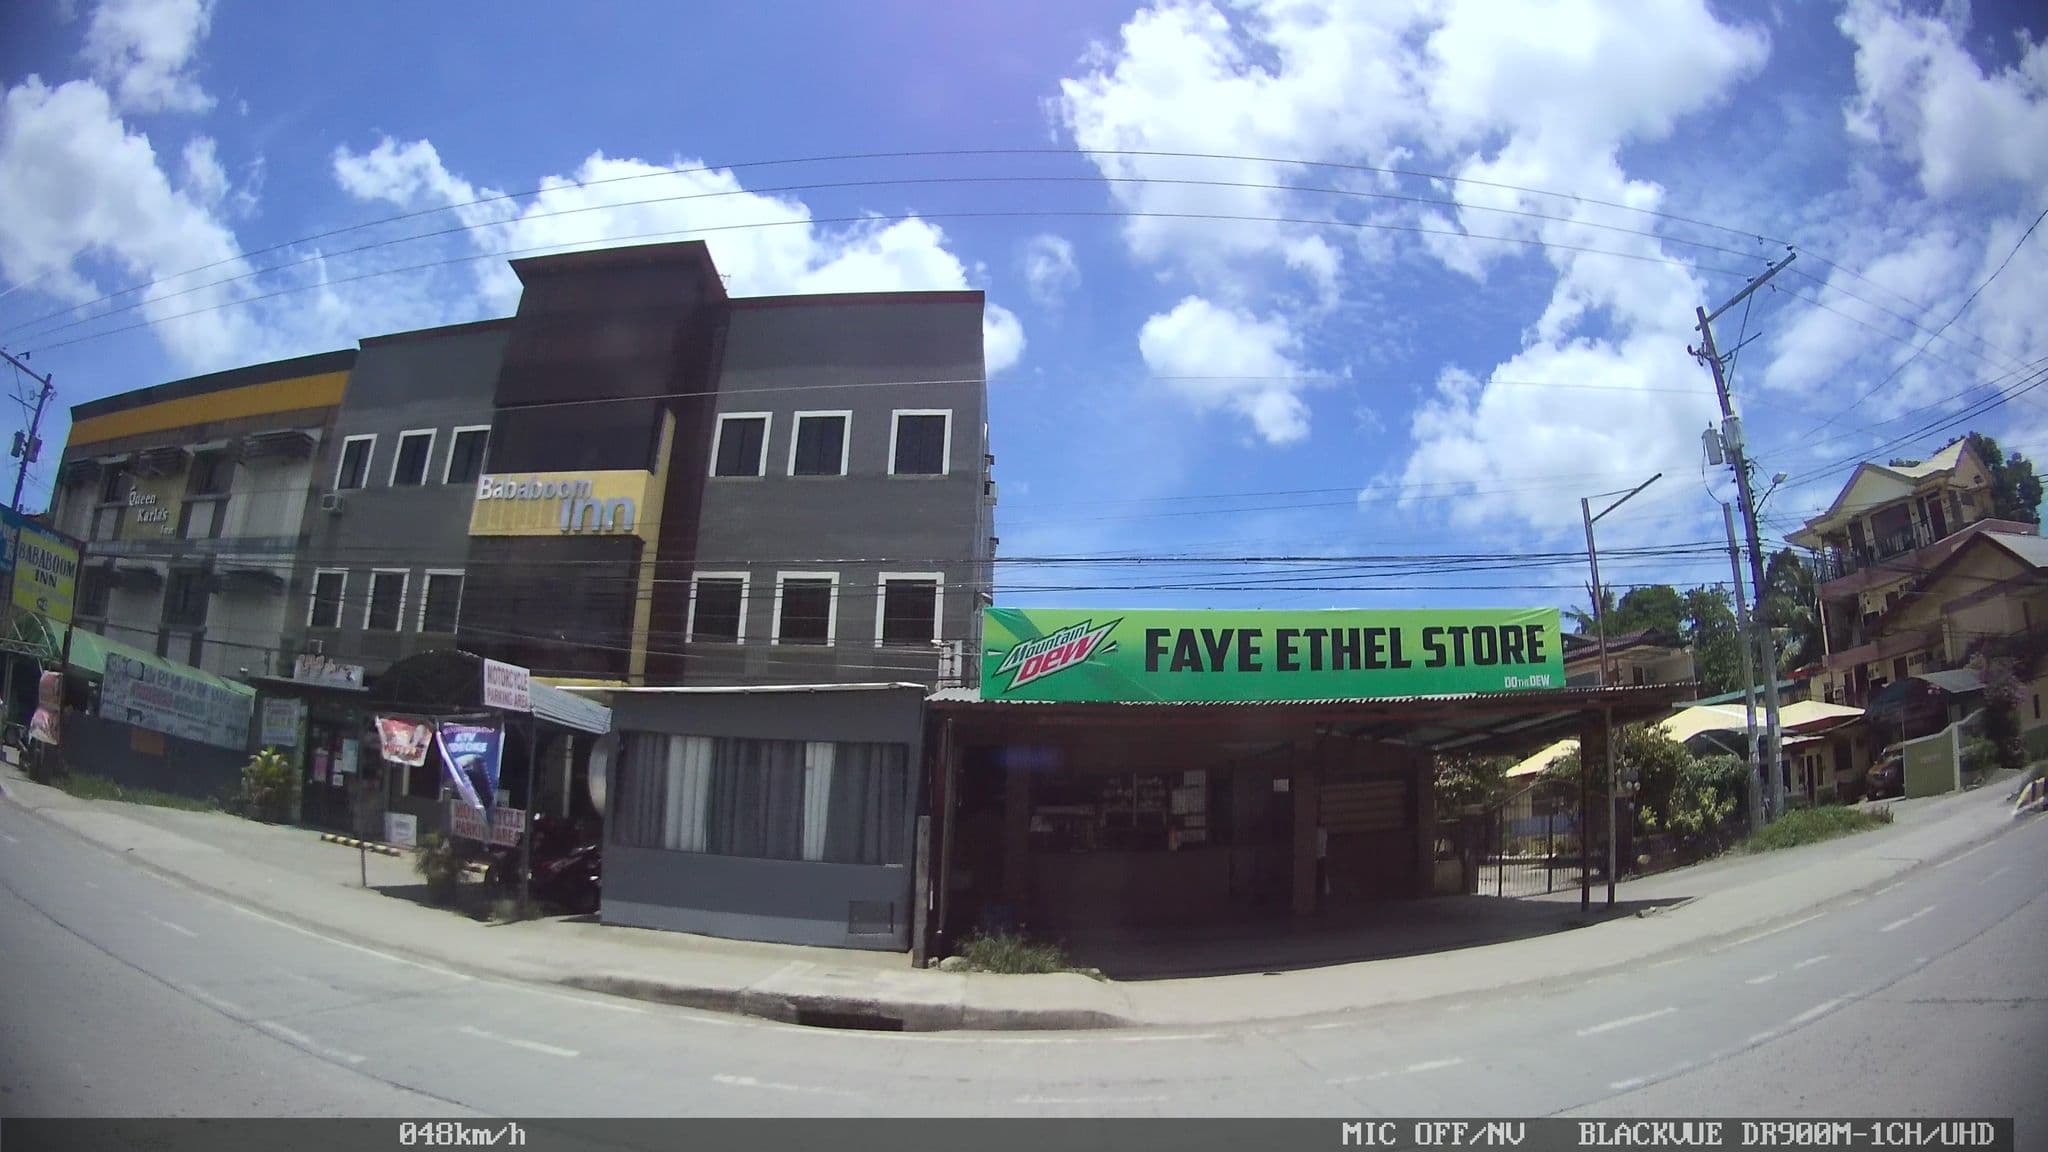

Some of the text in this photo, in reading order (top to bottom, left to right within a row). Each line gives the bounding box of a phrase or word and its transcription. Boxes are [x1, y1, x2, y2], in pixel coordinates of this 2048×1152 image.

[129, 490, 157, 506] Queen
[478, 473, 593, 501] Bababoom
[19, 542, 75, 577] BABABOOM
[35, 569, 58, 588] INN
[1005, 627, 1084, 667] Mountain
[1144, 624, 1548, 672] FAYE ETHEL STORE
[487, 664, 528, 691] MOTORCYCLE
[487, 687, 528, 708] PARKING AREA
